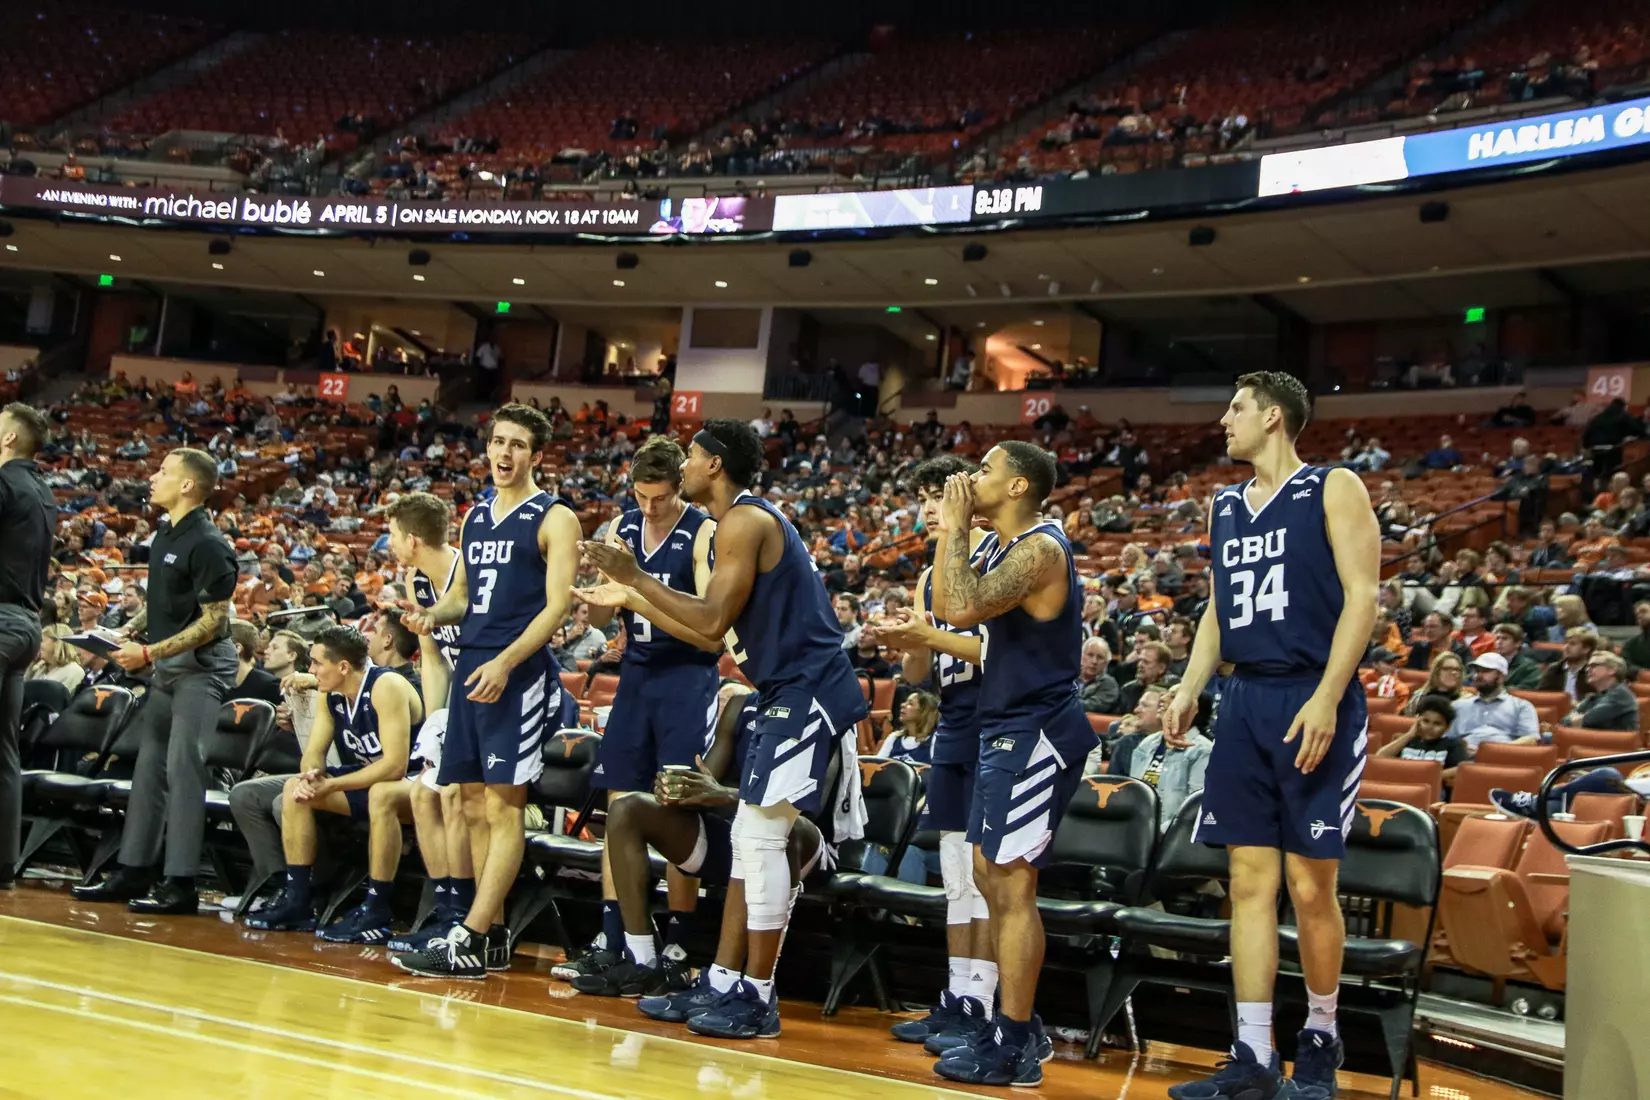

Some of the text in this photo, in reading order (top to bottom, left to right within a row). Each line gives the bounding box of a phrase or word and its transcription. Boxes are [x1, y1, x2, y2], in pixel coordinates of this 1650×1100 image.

[1467, 114, 1605, 161] HARLEM
[42, 189, 137, 209] AN EVENING WITH
[144, 193, 312, 224] michael bublé
[1014, 186, 1042, 213] PM
[320, 204, 388, 224] APRIL 5
[400, 209, 638, 226] ON SALE MONDAY, NOV. 18 AT 10AM
[322, 378, 345, 396] 22
[1592, 375, 1626, 398] 49
[676, 395, 698, 413] 21
[1025, 398, 1050, 417] 20
[1292, 488, 1313, 500] WAC
[468, 540, 515, 565] CBU
[1222, 528, 1287, 568] CBU
[472, 568, 498, 614] 3
[1229, 563, 1289, 630] 34
